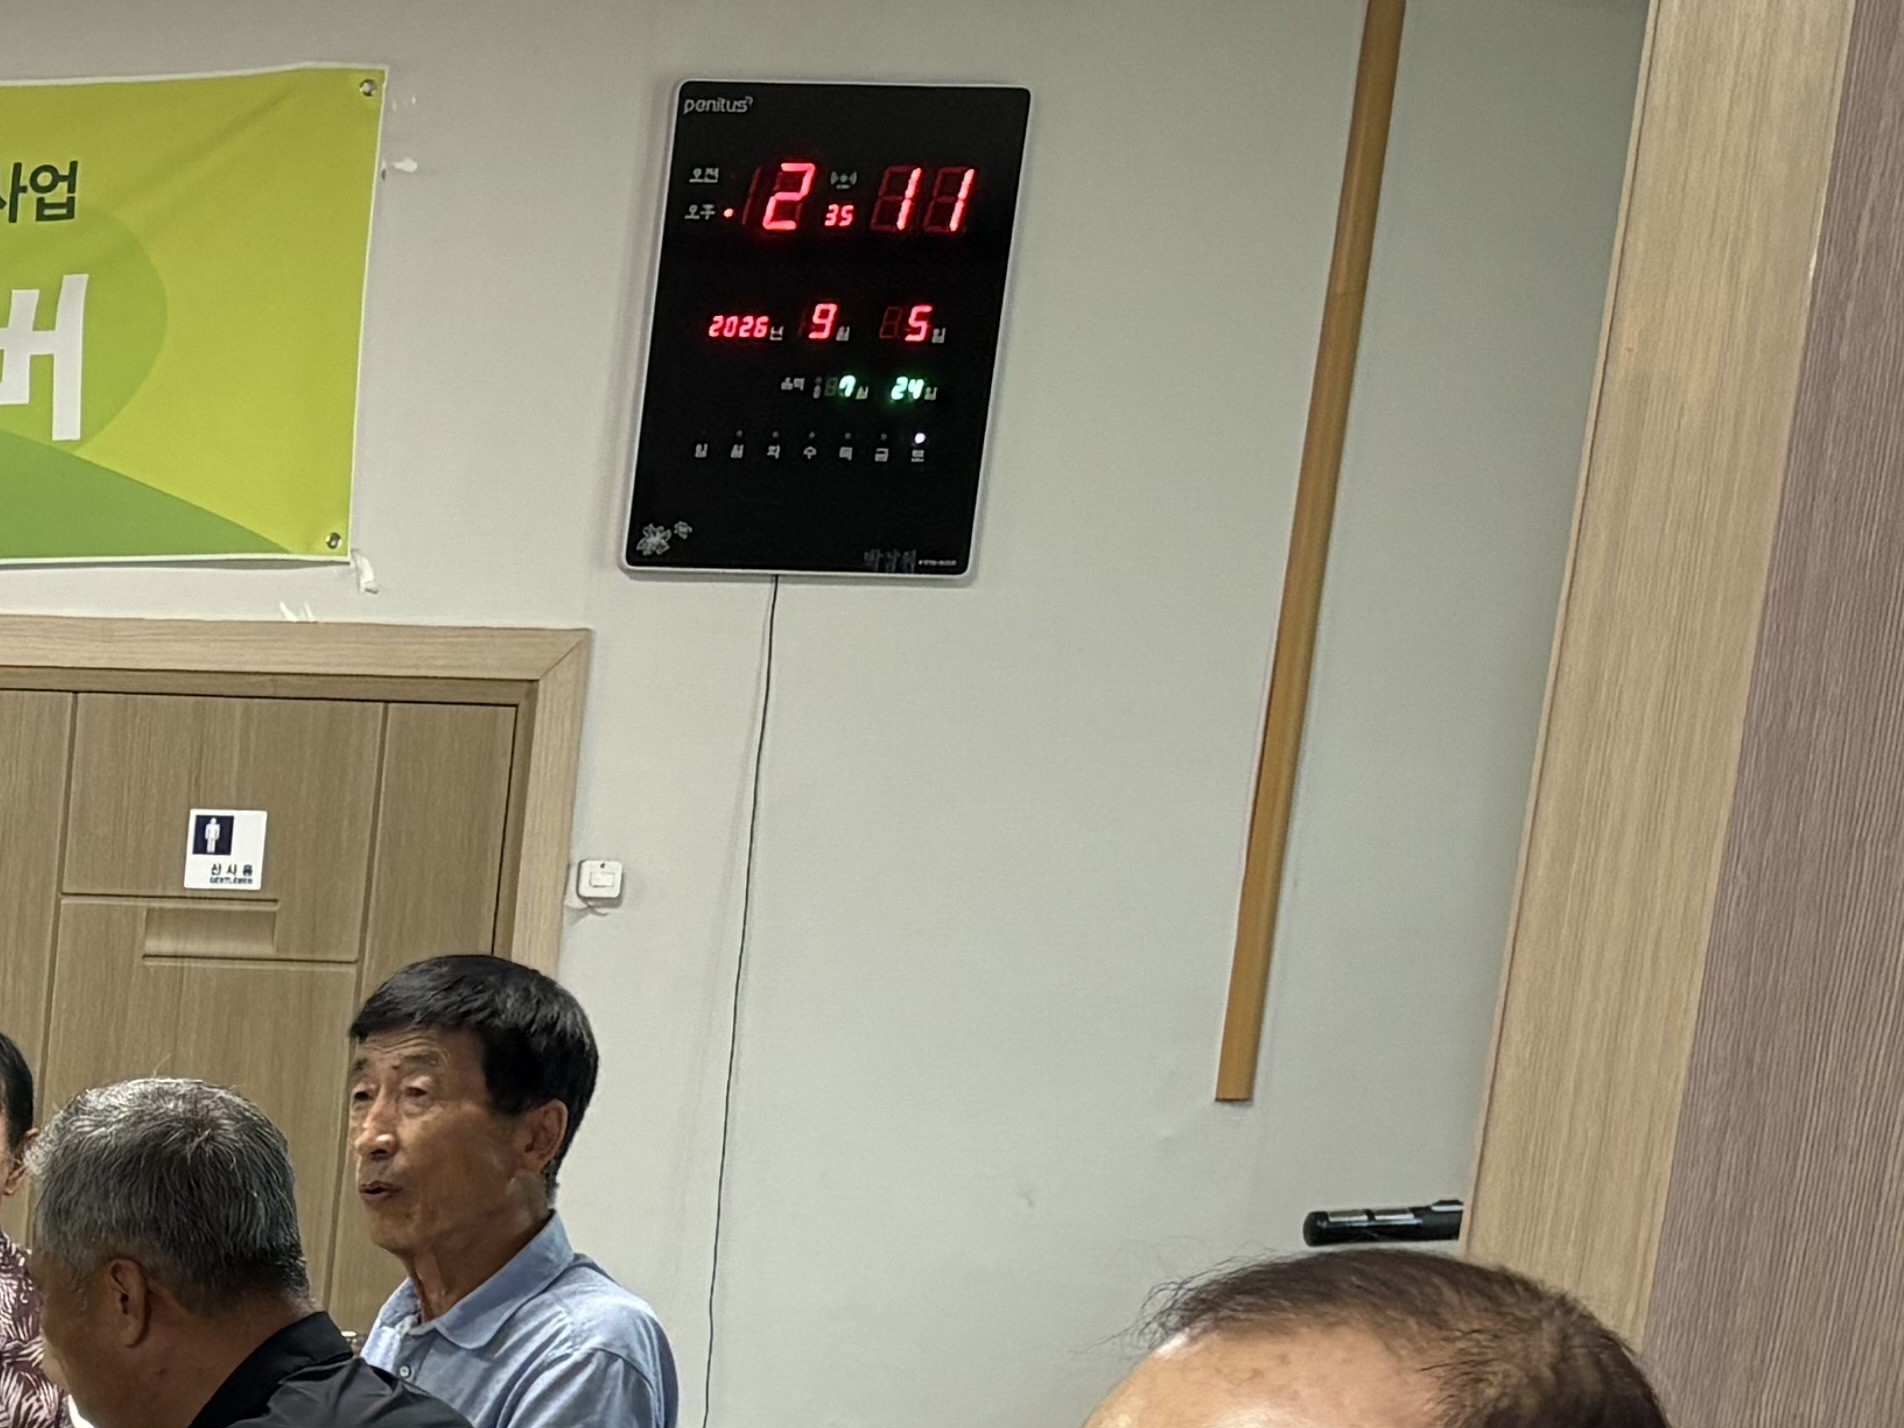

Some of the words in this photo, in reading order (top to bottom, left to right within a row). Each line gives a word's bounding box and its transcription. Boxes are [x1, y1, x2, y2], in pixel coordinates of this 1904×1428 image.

[762, 162, 816, 230] 2
[895, 167, 976, 232] 11
[824, 203, 855, 227] 35
